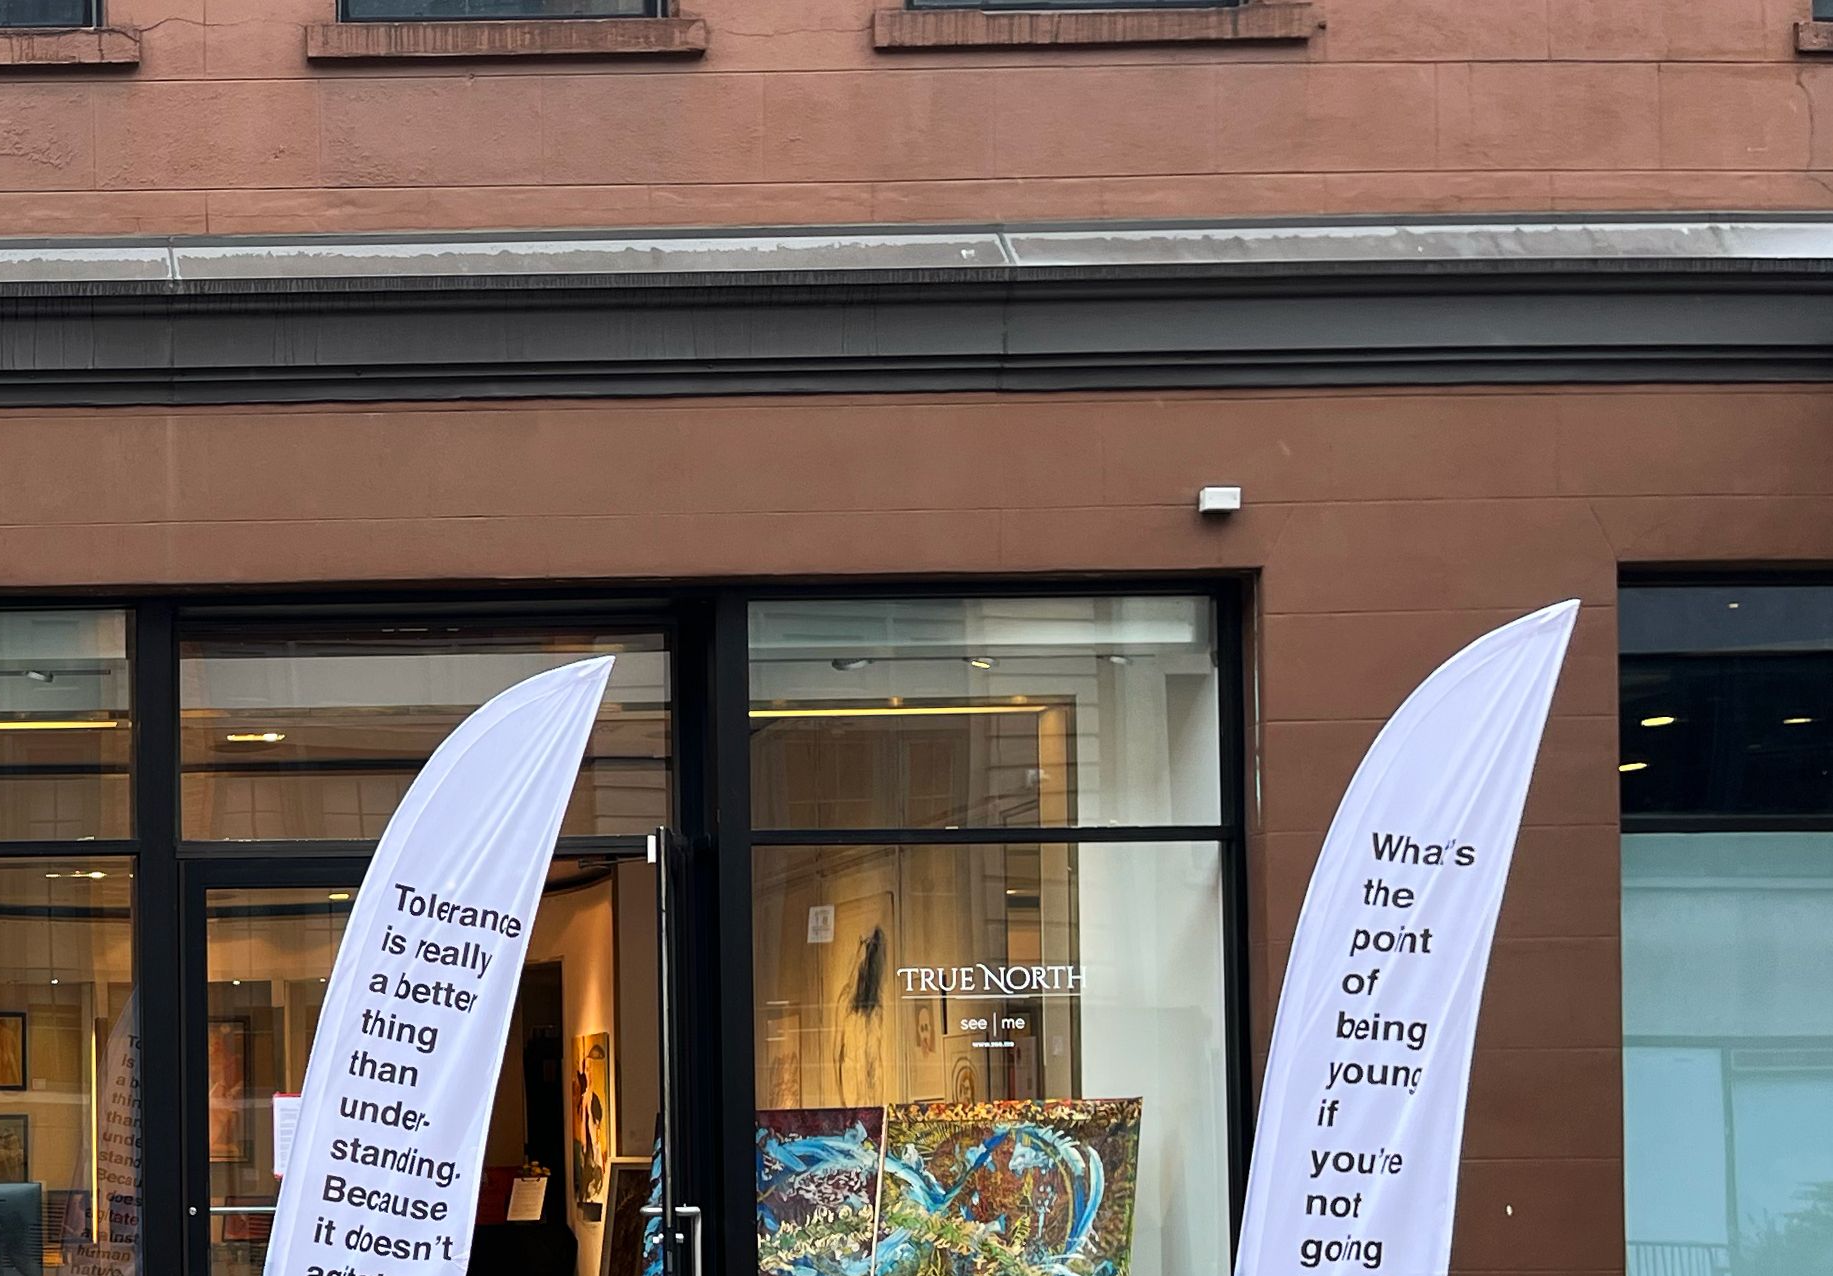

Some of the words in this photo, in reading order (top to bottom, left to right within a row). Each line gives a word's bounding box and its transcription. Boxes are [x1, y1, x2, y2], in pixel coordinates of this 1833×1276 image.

[394, 882, 522, 938] Tolerance
[1363, 878, 1415, 909] the
[381, 924, 407, 955] is
[414, 939, 493, 979] really
[1349, 925, 1433, 957] point
[368, 973, 389, 995] a
[394, 972, 477, 1013] better
[896, 967, 976, 992] TRUE
[976, 963, 1087, 994] NORTH
[1342, 968, 1380, 996] of
[360, 1008, 439, 1054] thing
[960, 1018, 988, 1031] see
[1001, 1018, 1026, 1030] me
[1336, 1010, 1428, 1051] being
[348, 1049, 418, 1087] than
[340, 1096, 430, 1132] under-
[1317, 1098, 1340, 1127] if
[330, 1137, 461, 1188] standing.
[1309, 1147, 1403, 1179] you're
[322, 1174, 449, 1221] Because
[1305, 1192, 1362, 1219] not
[313, 1216, 336, 1246] it
[344, 1224, 454, 1261] doesn't
[1300, 1234, 1383, 1270] going
